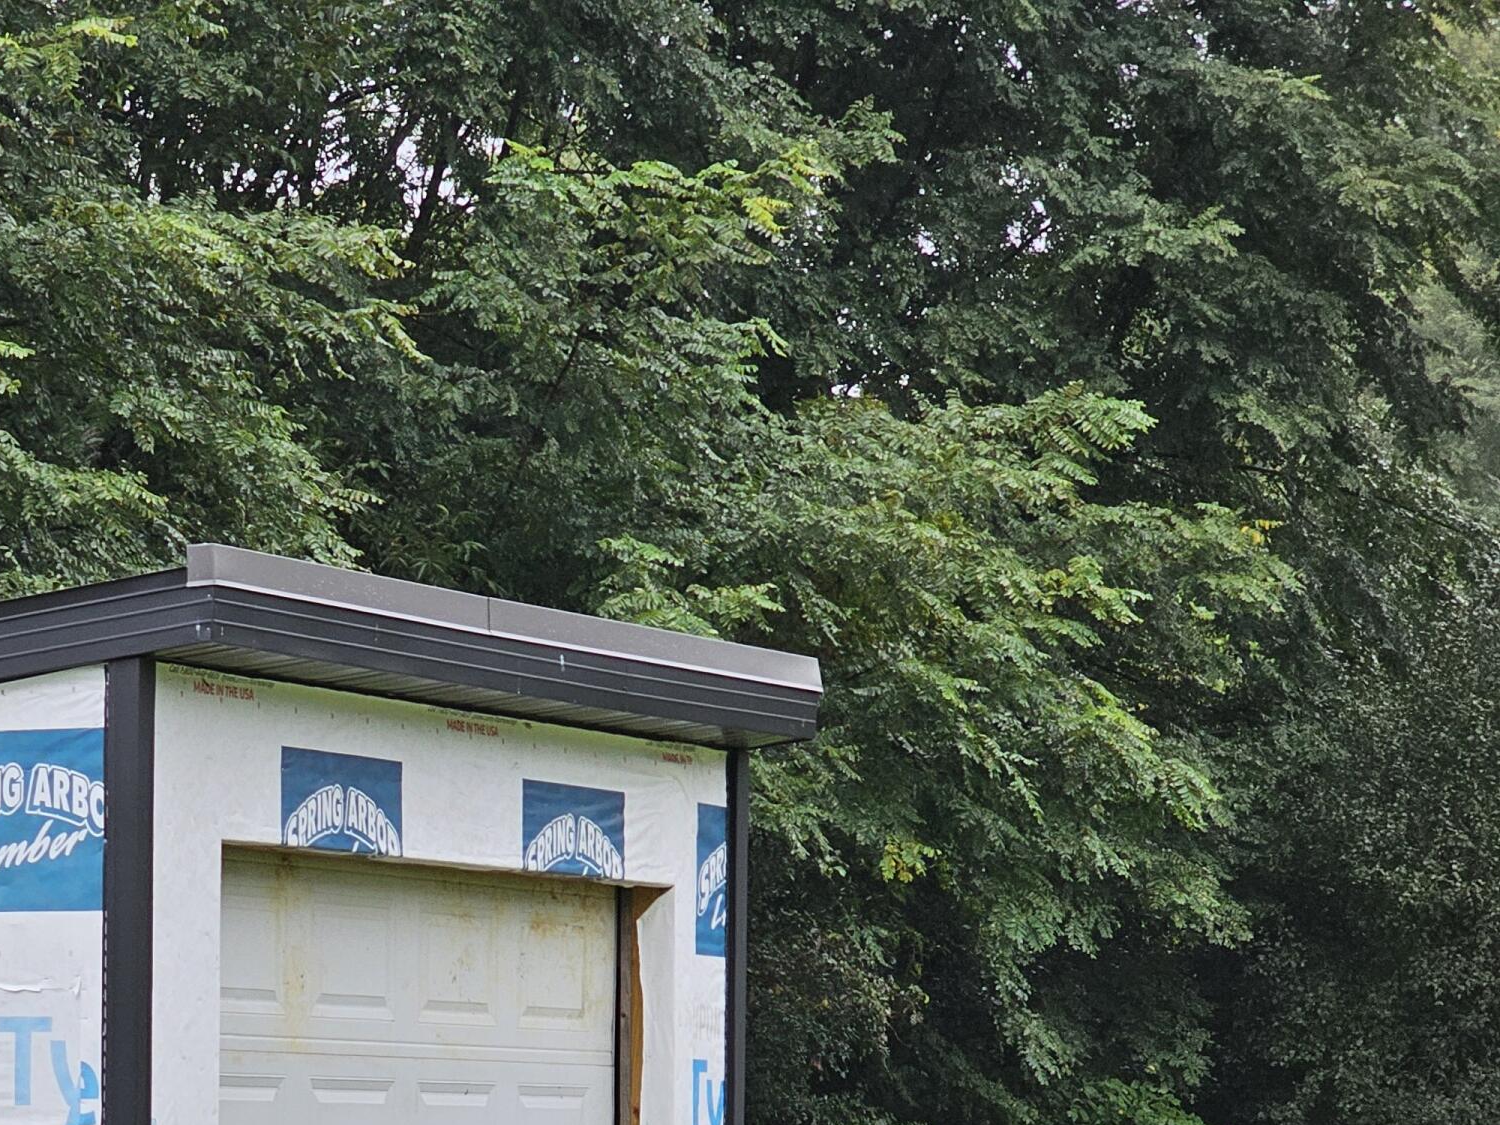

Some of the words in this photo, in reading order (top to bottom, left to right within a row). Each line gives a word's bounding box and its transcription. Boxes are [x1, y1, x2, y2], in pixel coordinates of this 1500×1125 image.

[216, 683, 224, 697] IN
[225, 684, 238, 699] THE
[240, 686, 254, 701] USA
[284, 784, 344, 847] SPRING
